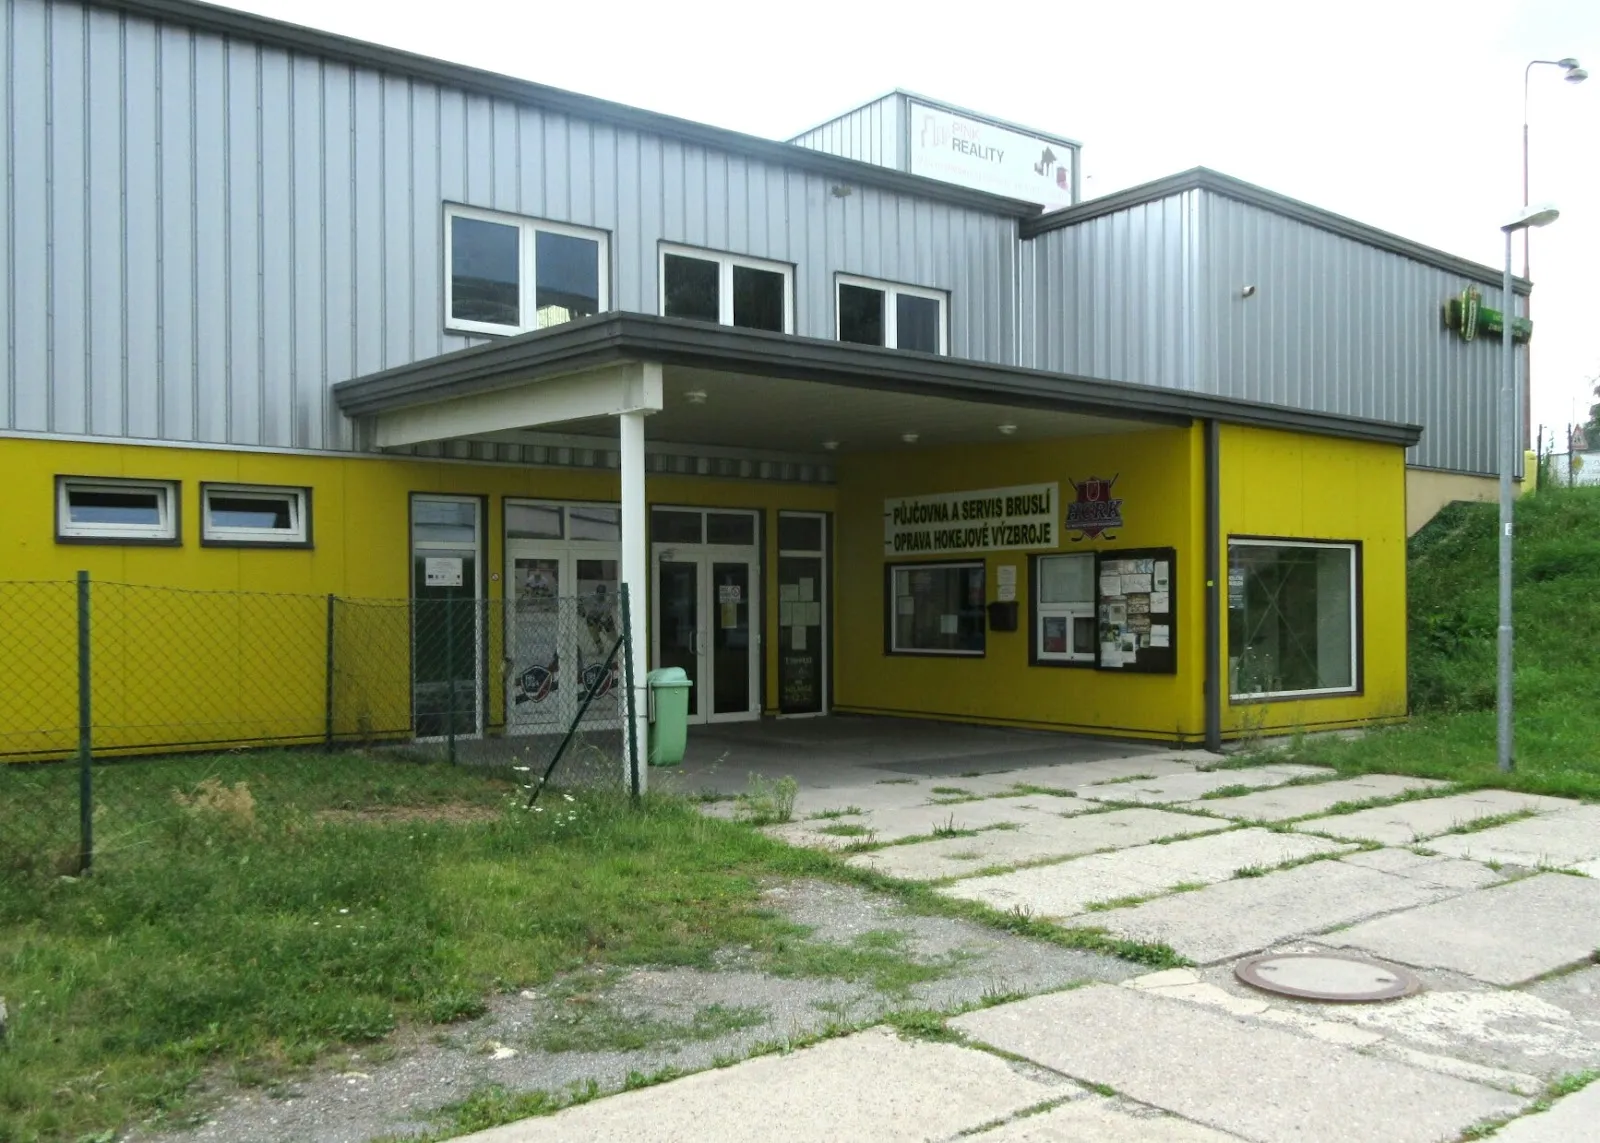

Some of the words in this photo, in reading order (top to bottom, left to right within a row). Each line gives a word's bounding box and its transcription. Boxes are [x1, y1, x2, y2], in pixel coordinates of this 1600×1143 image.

[952, 137, 1004, 164] REALITY
[893, 501, 949, 525] PŮJČOVNA
[952, 505, 958, 521] A
[962, 497, 1002, 520] SERVIS
[1006, 488, 1050, 517] BRUSLÍ
[894, 531, 931, 551] OPRAVA
[934, 523, 989, 550] HOKEJOVÉ
[992, 522, 1051, 546] VÝZBROJE
